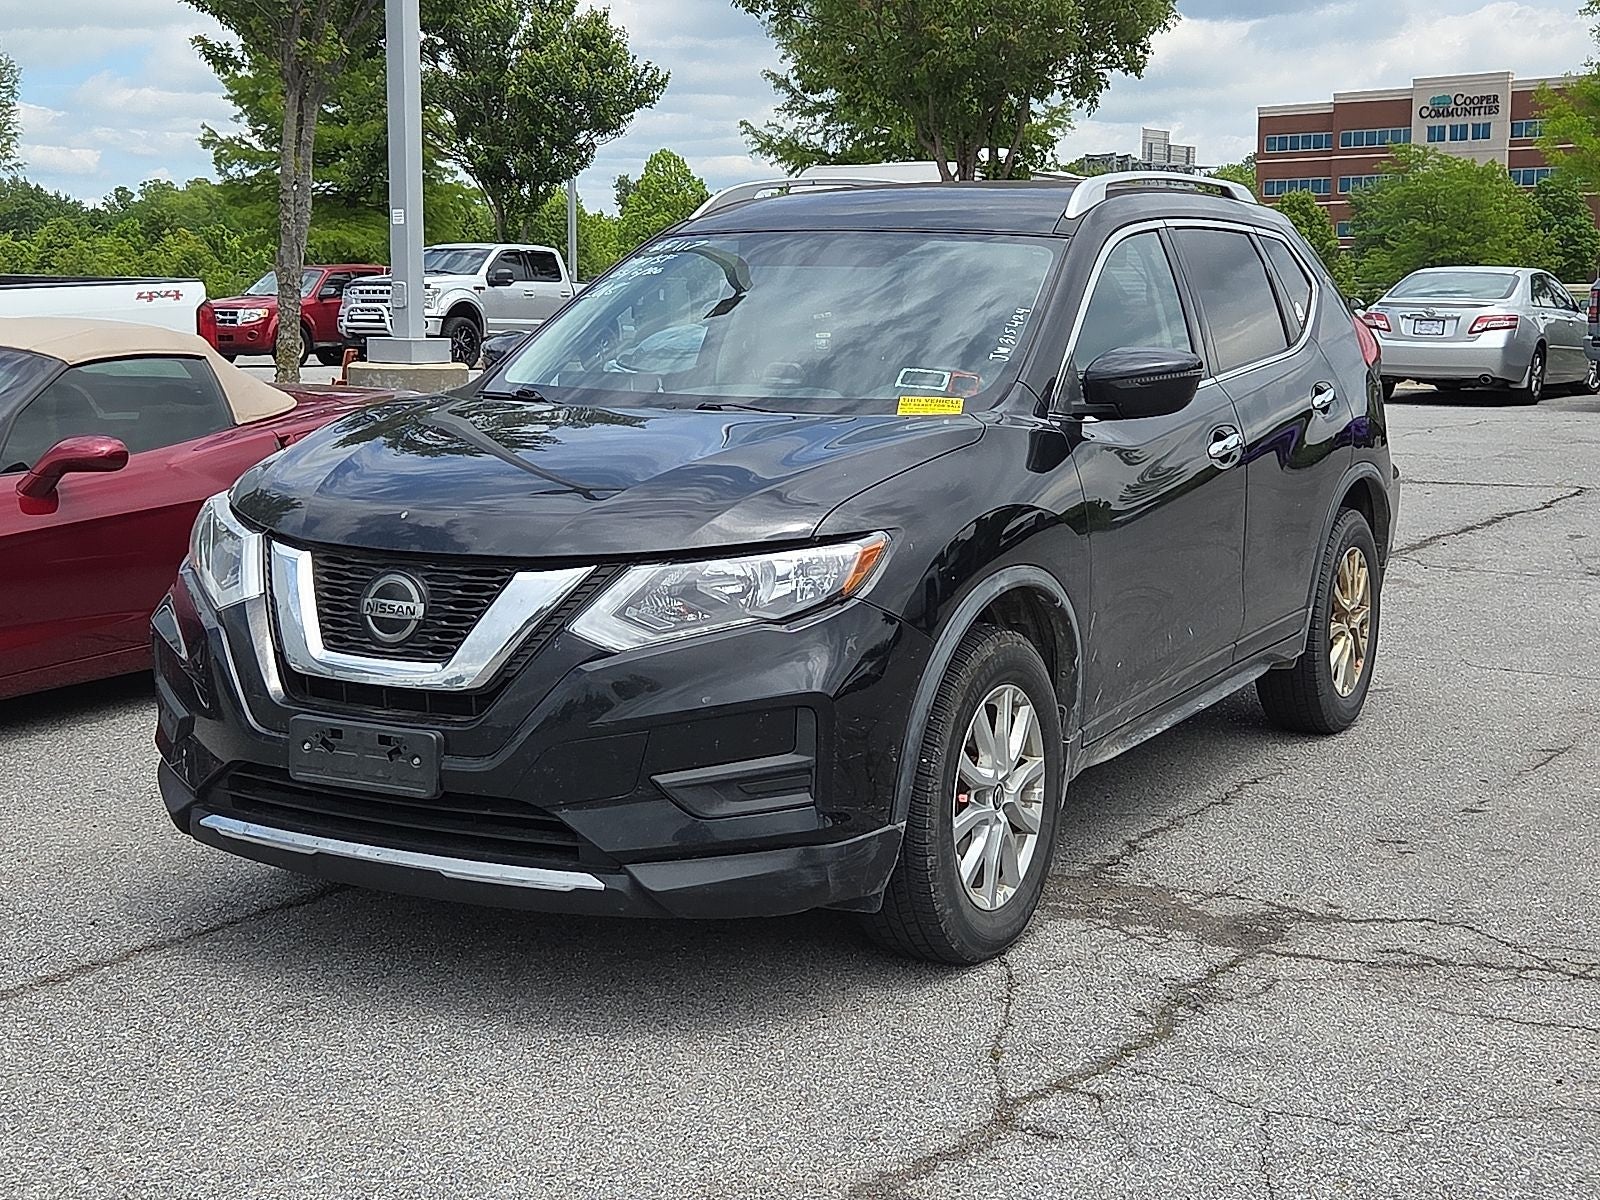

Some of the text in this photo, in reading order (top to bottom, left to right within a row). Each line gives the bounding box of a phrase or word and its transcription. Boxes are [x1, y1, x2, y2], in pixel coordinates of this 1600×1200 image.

[1453, 93, 1499, 106] COOPER
[1419, 105, 1500, 119] COMMUNITIES
[365, 601, 416, 616] NISSAN
